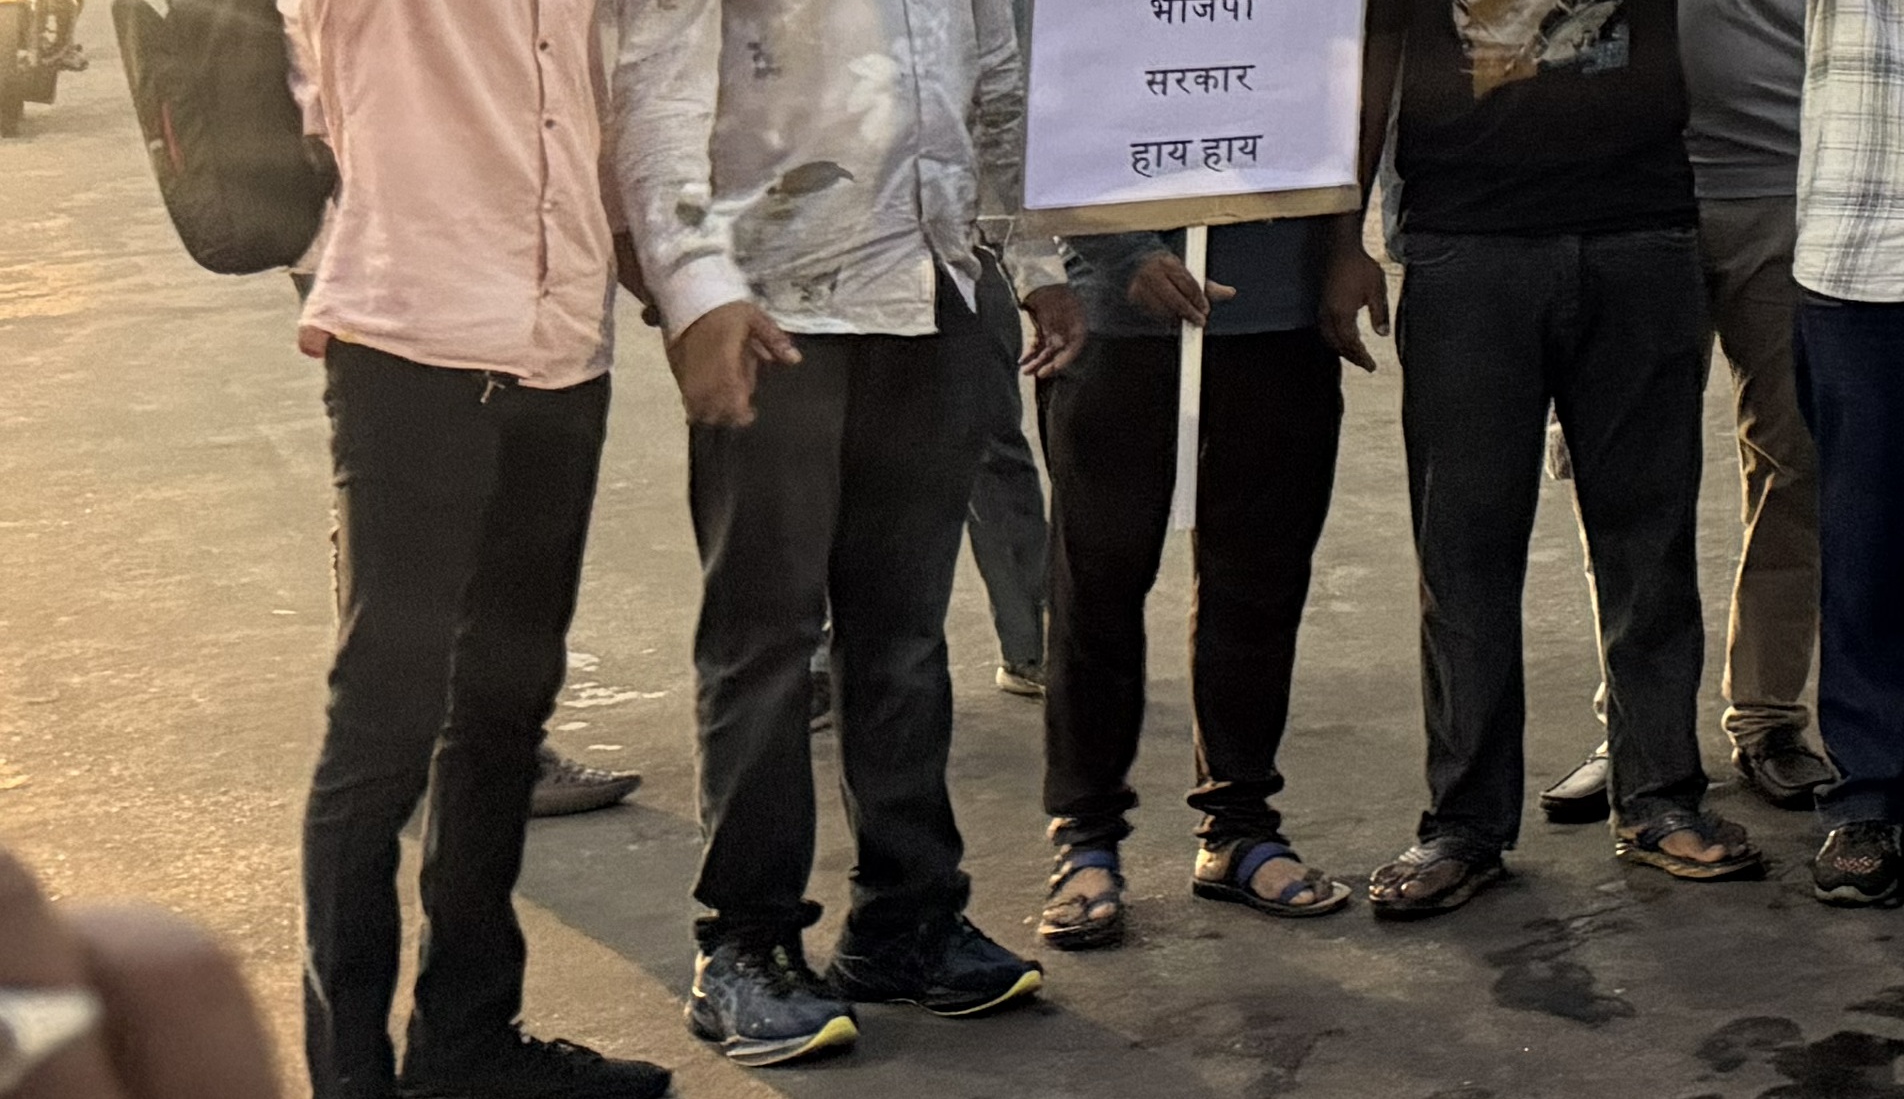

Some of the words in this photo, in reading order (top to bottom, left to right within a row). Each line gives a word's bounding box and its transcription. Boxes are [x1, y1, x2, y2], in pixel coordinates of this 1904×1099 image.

[1144, 64, 1257, 97] सरकार
[1129, 139, 1194, 178] हाय
[1200, 134, 1265, 173] हाय
